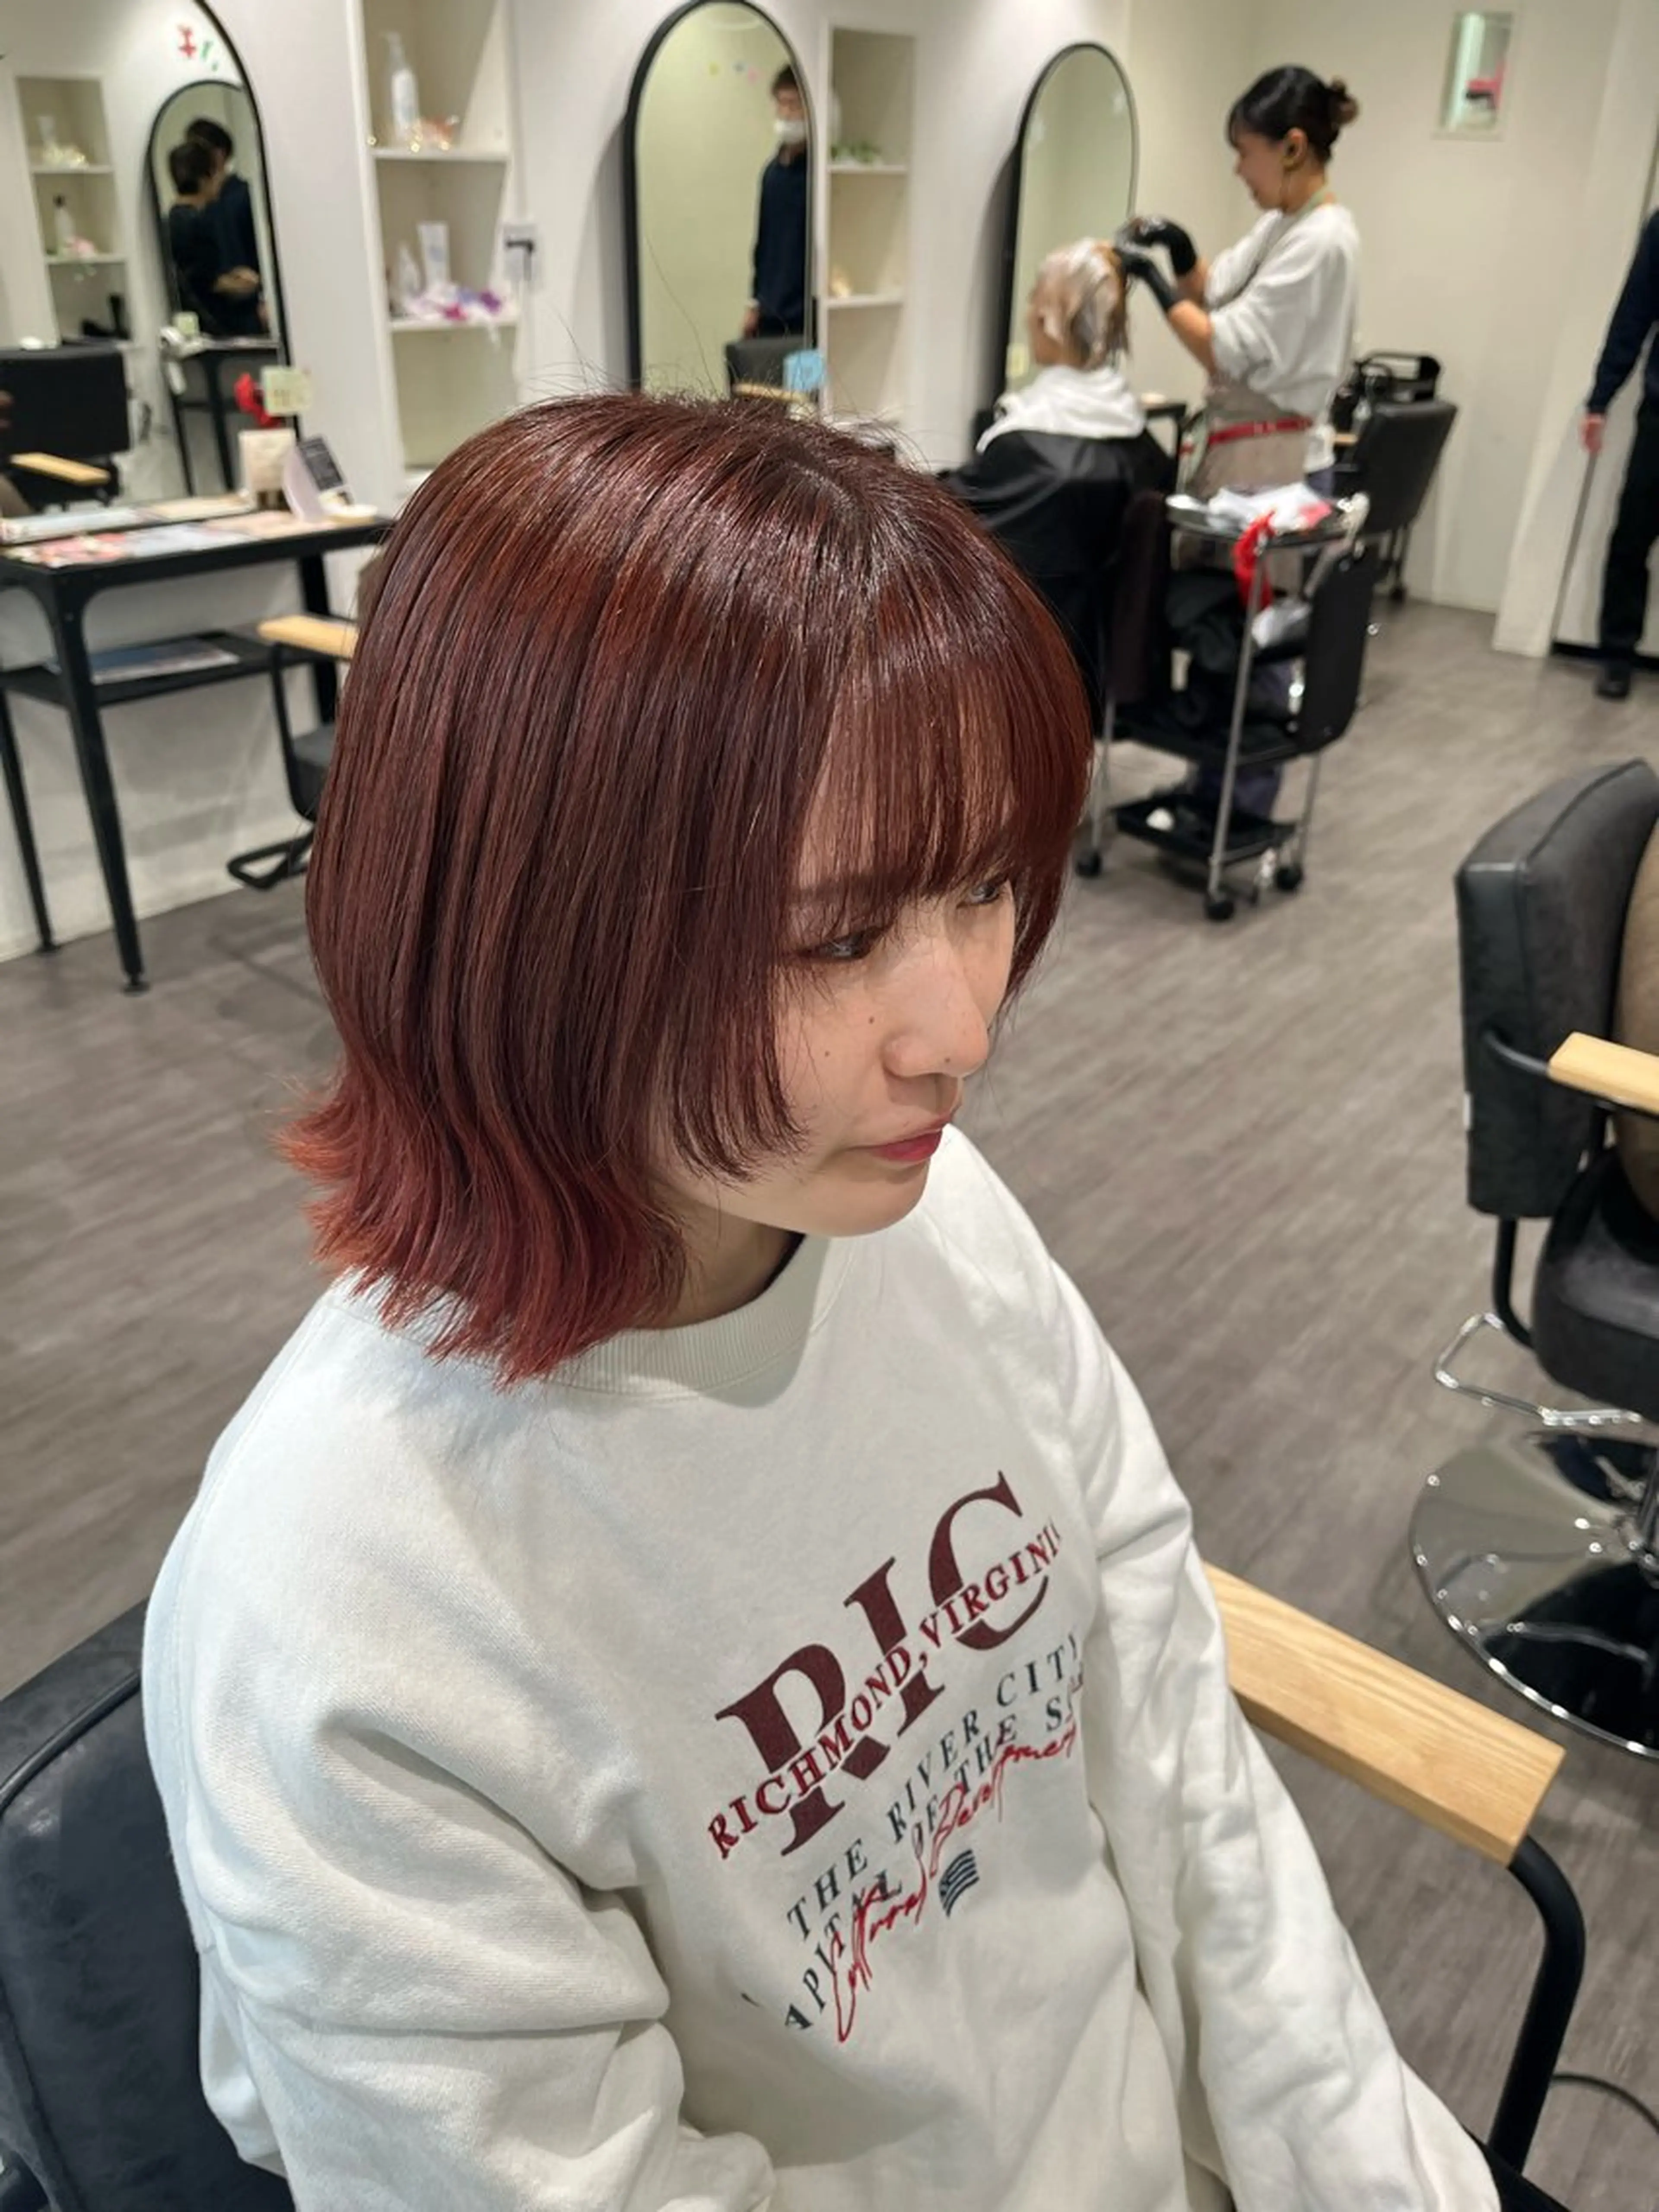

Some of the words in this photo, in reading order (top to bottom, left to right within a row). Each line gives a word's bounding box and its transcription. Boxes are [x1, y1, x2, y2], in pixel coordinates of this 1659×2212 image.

[715, 1470, 1049, 1856] RIC
[918, 1515, 1062, 1648] VIRGINI
[741, 1869, 902, 2030] APITAL
[953, 1713, 1018, 1795] THE
[786, 1838, 868, 1941] THE
[887, 1709, 981, 1844] RIVER
